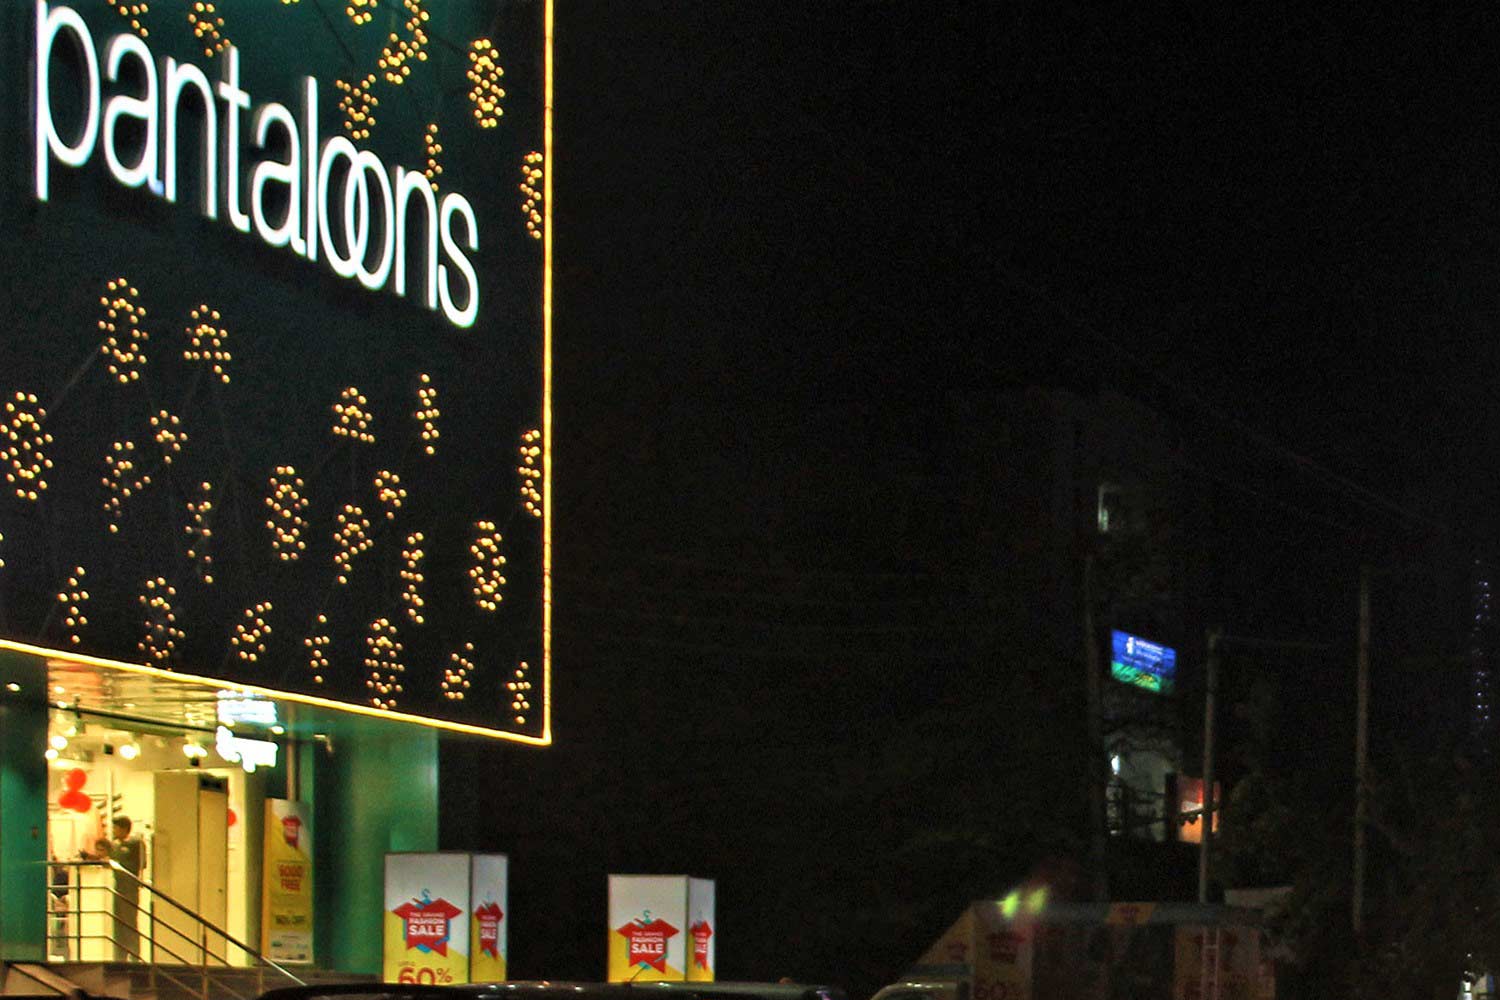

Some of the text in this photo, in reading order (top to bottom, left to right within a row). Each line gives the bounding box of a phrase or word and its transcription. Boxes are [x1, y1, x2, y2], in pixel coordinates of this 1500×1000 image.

[35, 0, 480, 329] pantaloons
[408, 924, 445, 936] SALE
[631, 943, 664, 954] SALE
